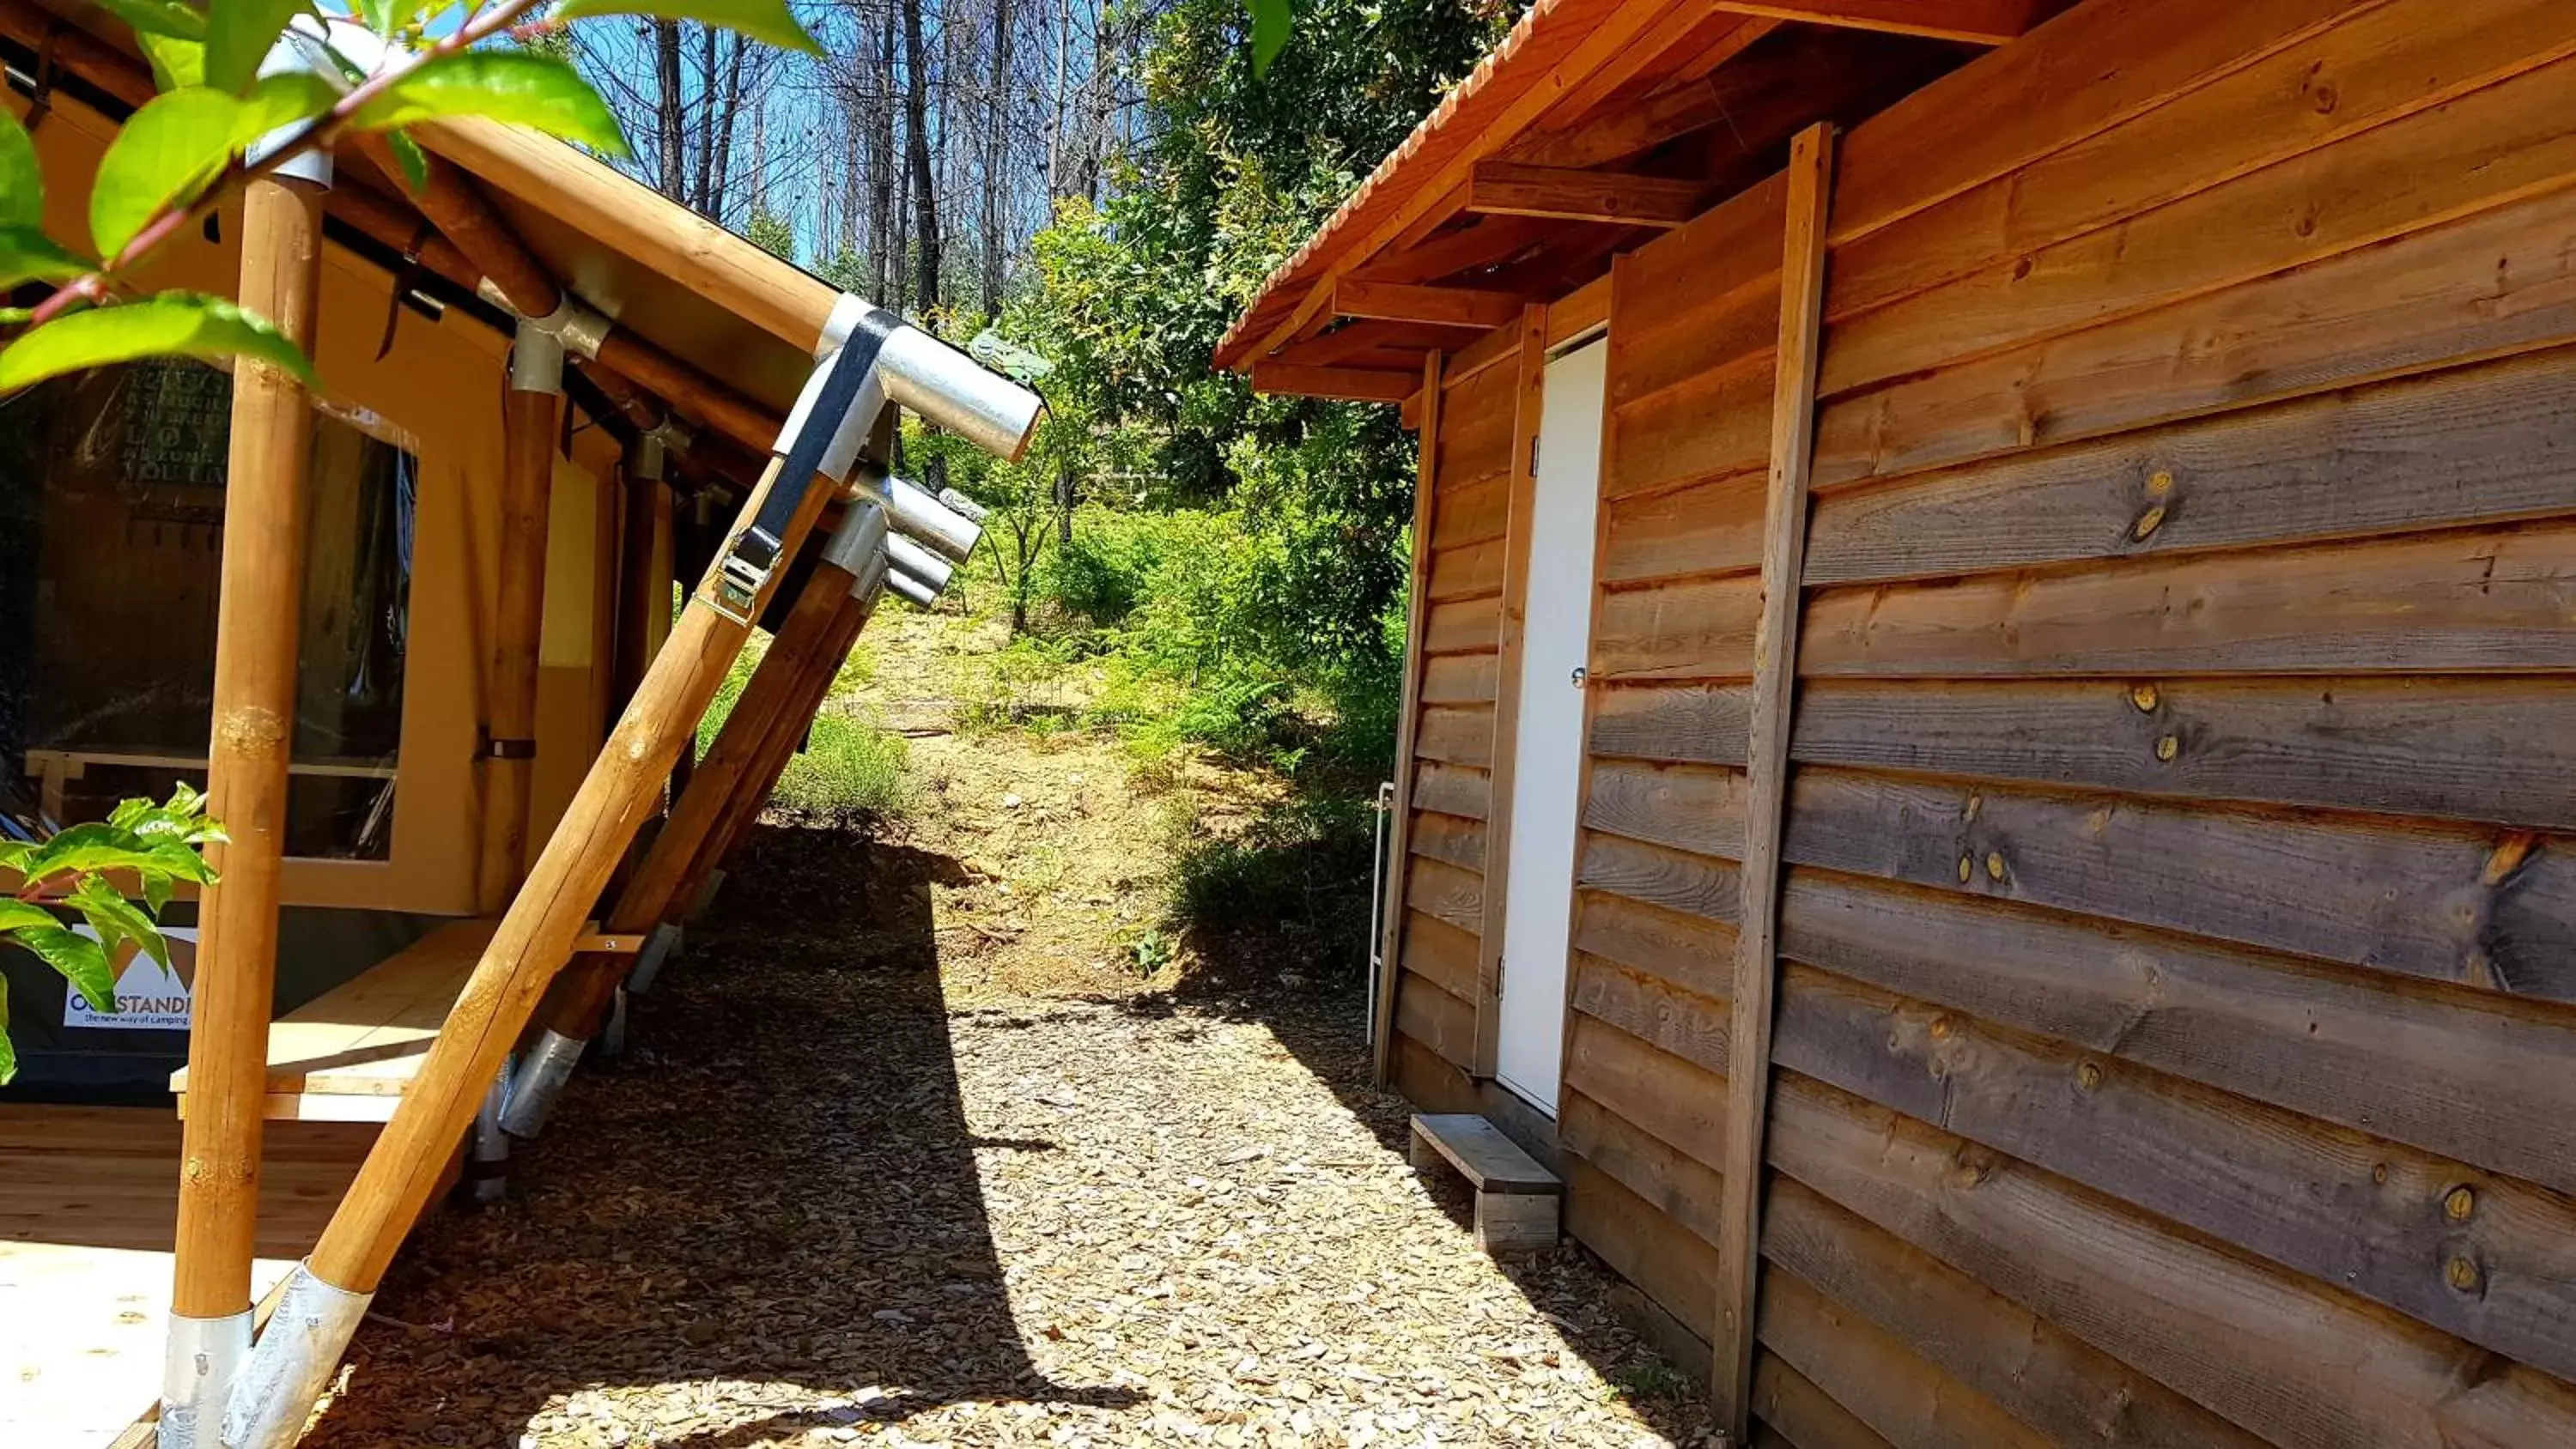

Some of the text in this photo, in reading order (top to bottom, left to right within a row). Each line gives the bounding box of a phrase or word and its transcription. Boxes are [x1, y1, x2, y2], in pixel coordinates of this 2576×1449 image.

[70, 993, 191, 1014] OSTANDI
[85, 1014, 99, 1022] the
[140, 1015, 149, 1023] of
